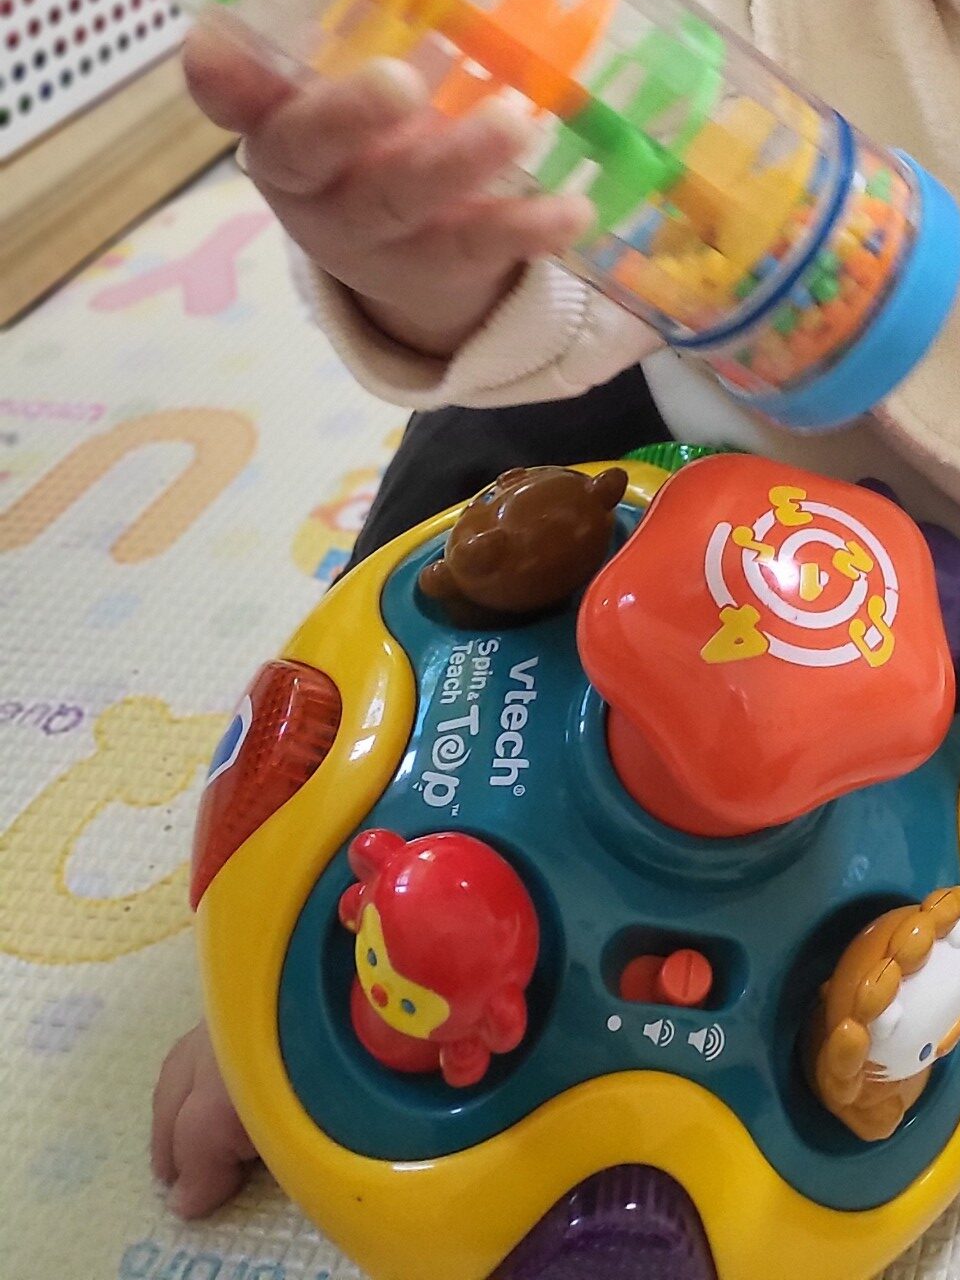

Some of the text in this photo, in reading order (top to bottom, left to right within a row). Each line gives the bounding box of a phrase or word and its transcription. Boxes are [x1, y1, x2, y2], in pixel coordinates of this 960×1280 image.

[767, 485, 814, 527] 3
[699, 604, 771, 665] 4
[439, 639, 474, 704] Teach
[468, 637, 500, 690] Spin
